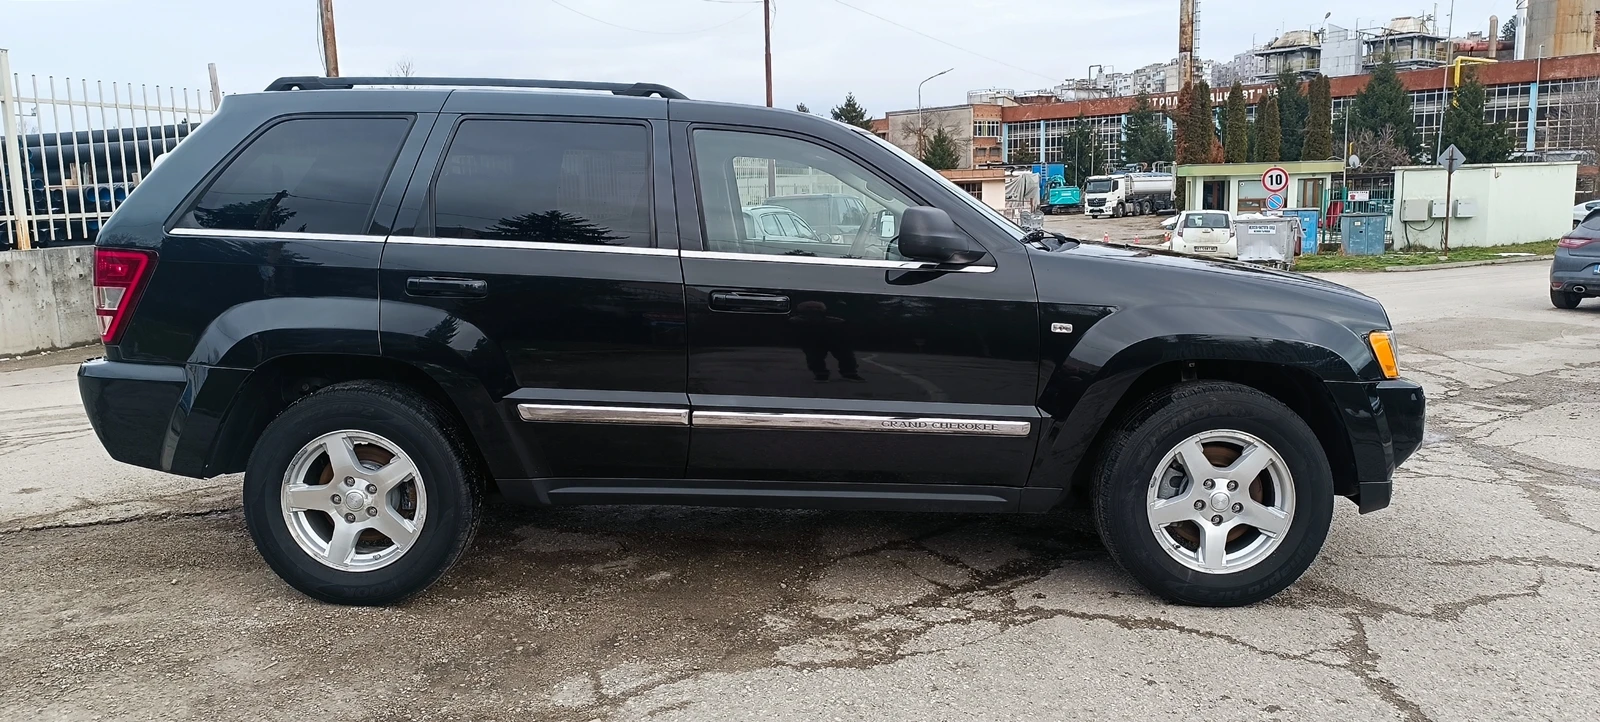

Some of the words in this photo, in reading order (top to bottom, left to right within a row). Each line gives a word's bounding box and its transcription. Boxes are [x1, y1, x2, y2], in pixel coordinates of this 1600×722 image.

[1268, 174, 1283, 186] 10
[881, 420, 928, 428] GRAND
[931, 422, 1000, 431] CHEROKEE
